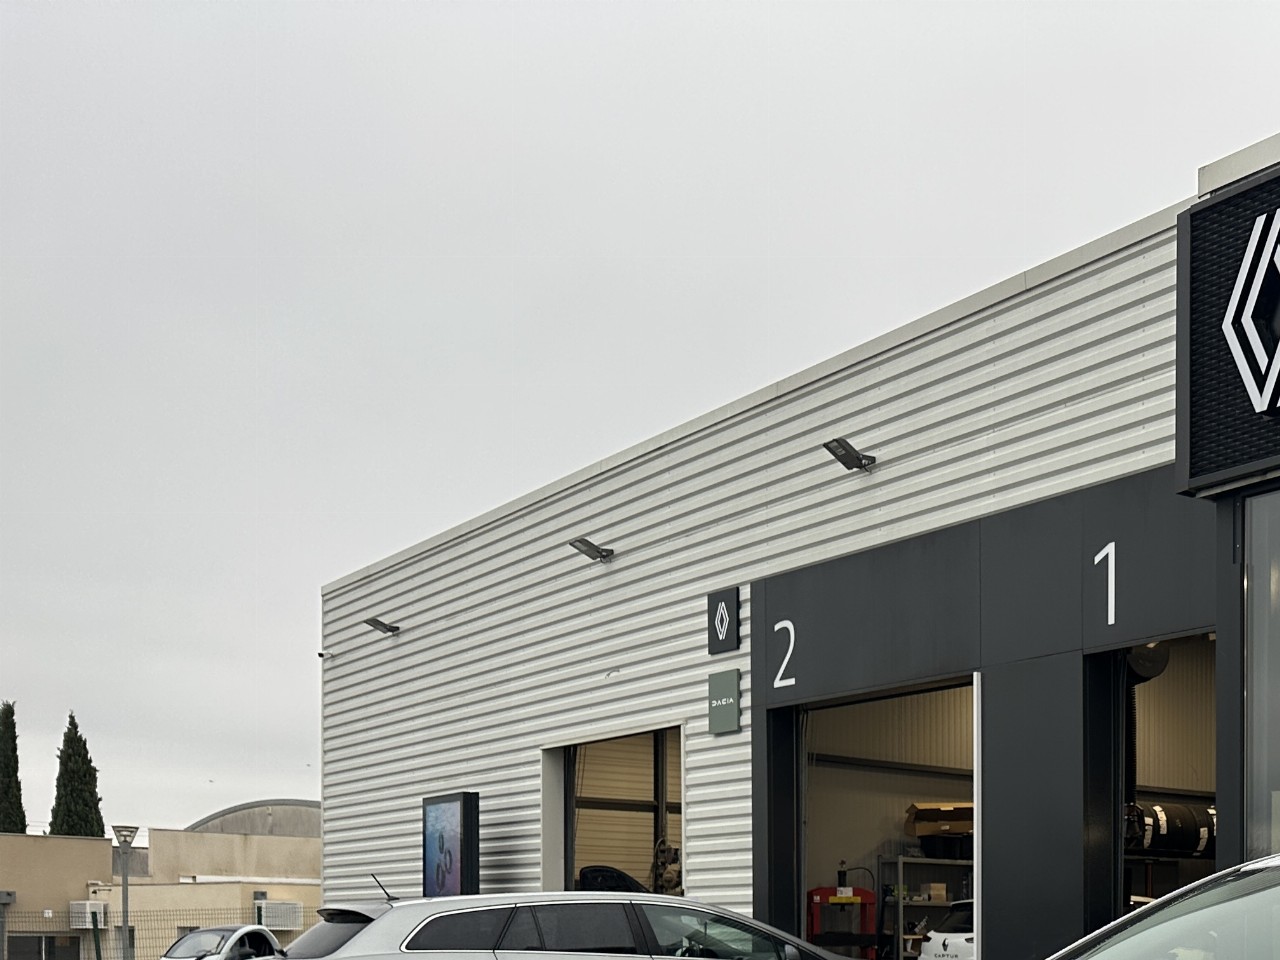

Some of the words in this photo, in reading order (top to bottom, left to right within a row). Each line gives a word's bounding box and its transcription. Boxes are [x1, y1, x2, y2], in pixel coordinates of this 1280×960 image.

[1094, 541, 1116, 625] 1
[773, 619, 796, 689] 2
[711, 697, 735, 707] DACIA
